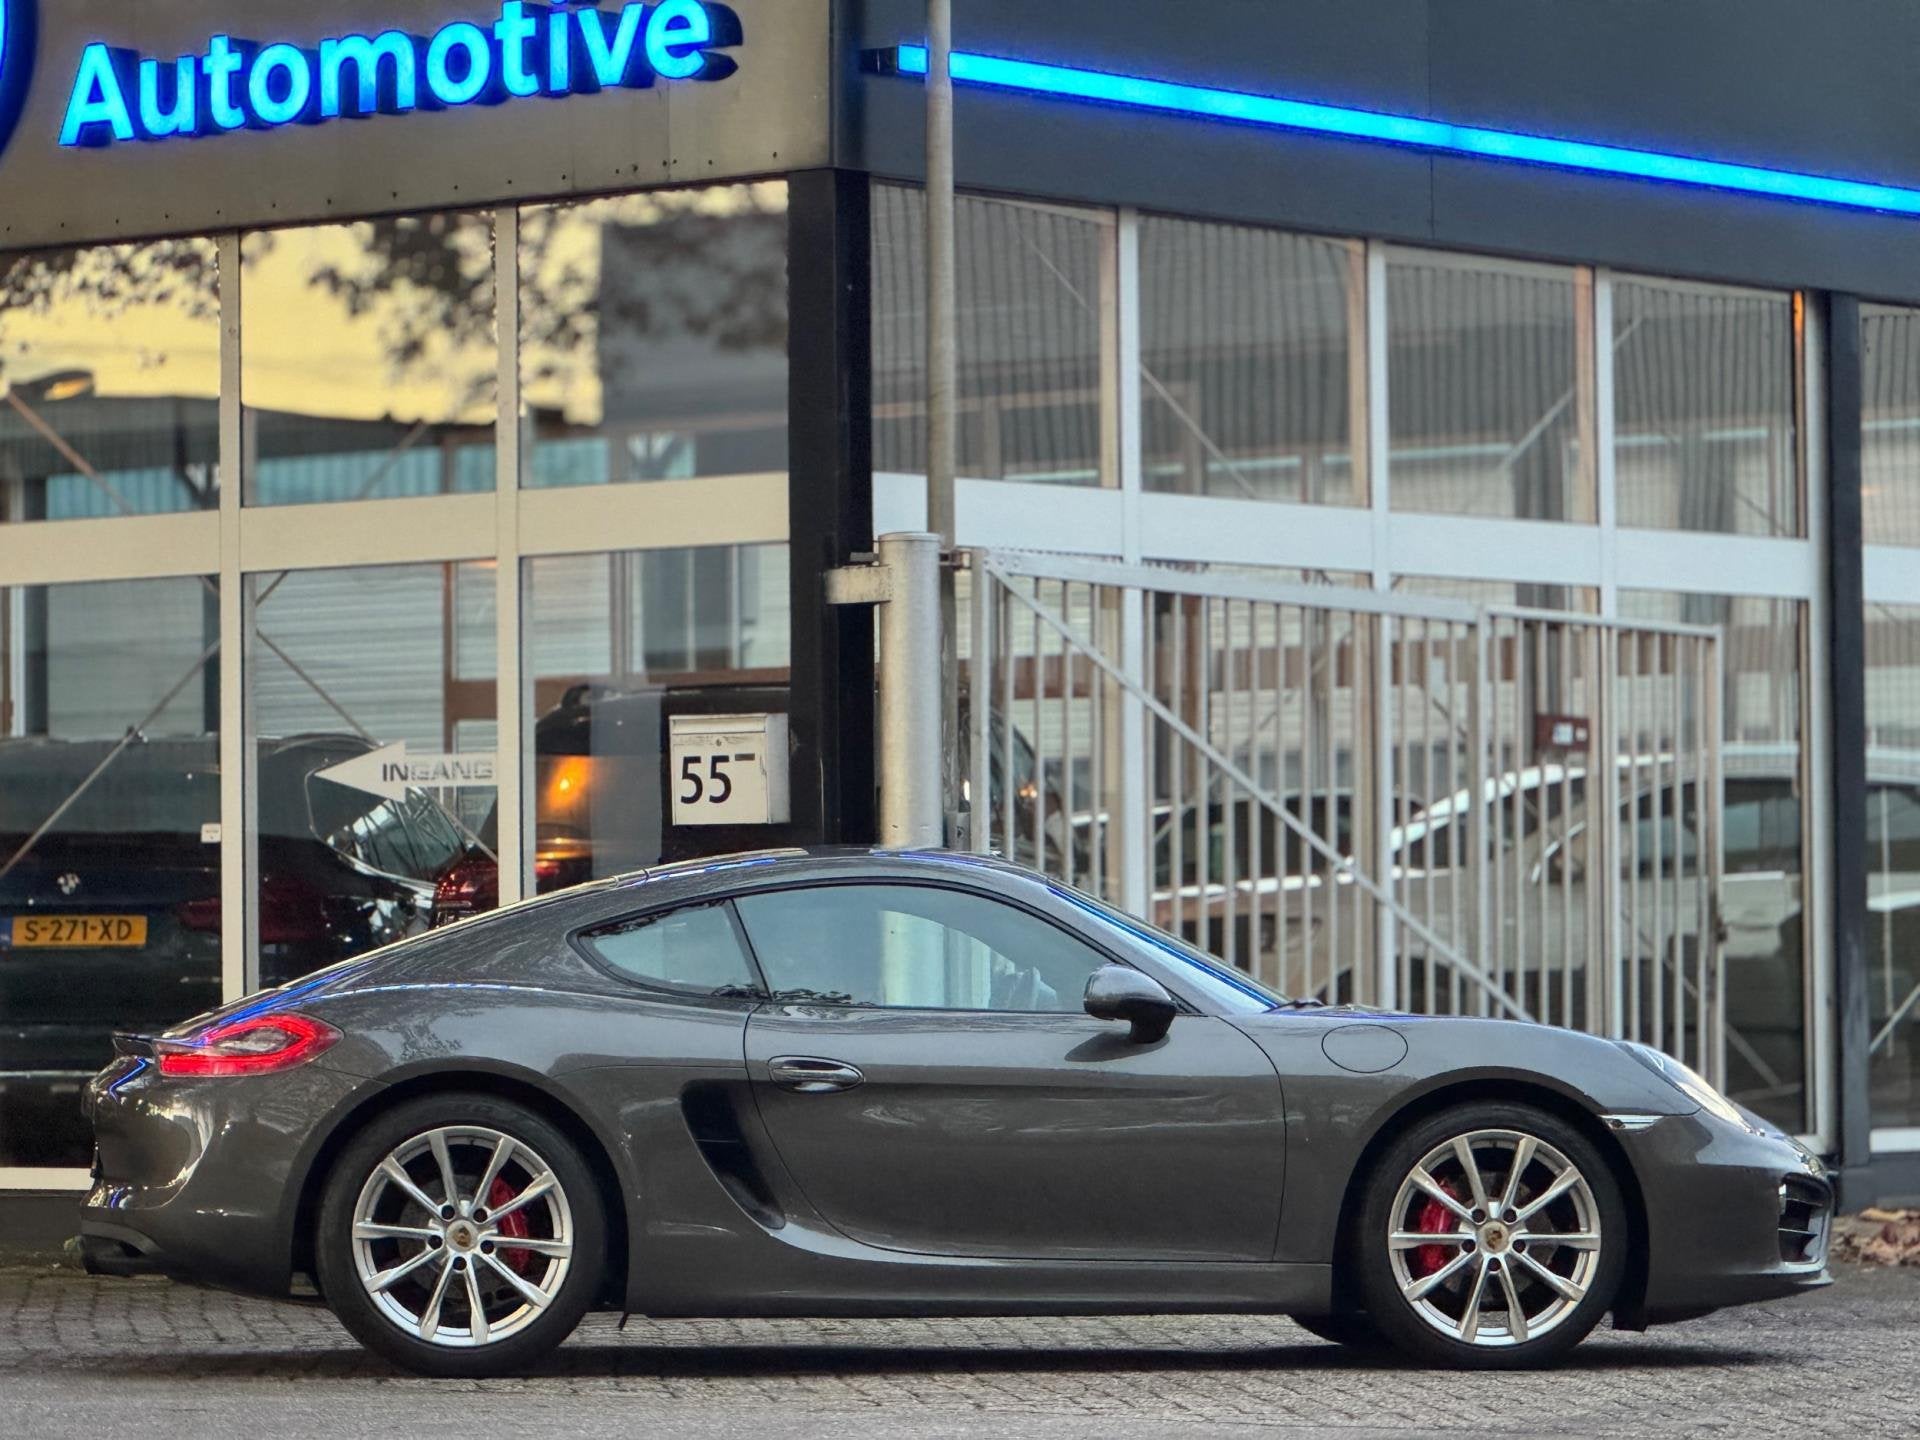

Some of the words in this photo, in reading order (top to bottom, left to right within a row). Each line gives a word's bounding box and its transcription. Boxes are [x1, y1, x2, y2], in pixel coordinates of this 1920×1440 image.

[57, 0, 713, 147] Automotive
[382, 760, 493, 782] INGANG
[24, 919, 133, 942] S-271-XD
